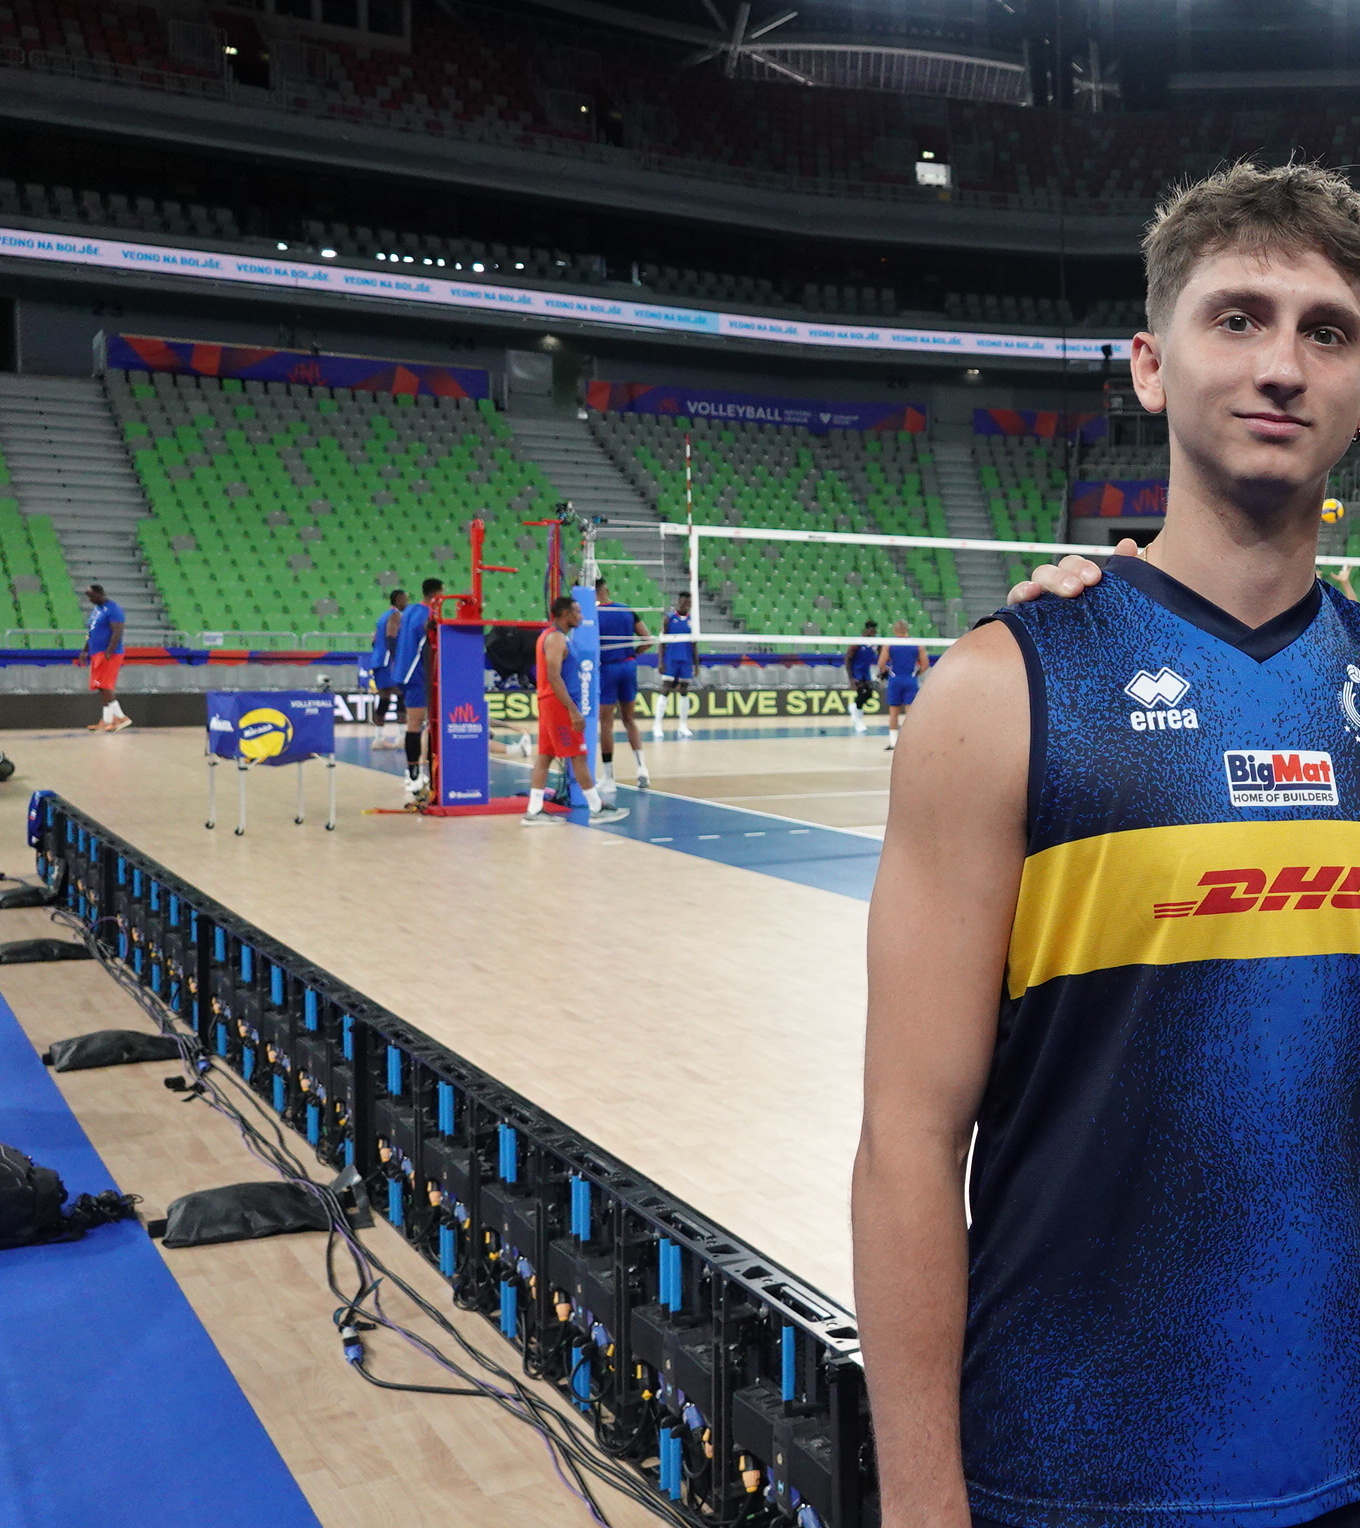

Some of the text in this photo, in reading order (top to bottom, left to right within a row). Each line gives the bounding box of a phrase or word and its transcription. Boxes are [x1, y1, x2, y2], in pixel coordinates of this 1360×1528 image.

[37, 242, 54, 251] NA
[122, 250, 160, 263] VEDNO
[163, 255, 178, 264] NA
[236, 263, 273, 276] VEDNO
[274, 268, 288, 277] NA
[344, 275, 377, 288] VEDNO
[379, 280, 392, 289] NA
[687, 400, 782, 421] VOLLEYBALL
[708, 691, 778, 716] LIVE
[786, 690, 881, 715] STATS
[1227, 754, 1331, 791] BigMat
[1233, 793, 1334, 803] HOME OF BUILDERS
